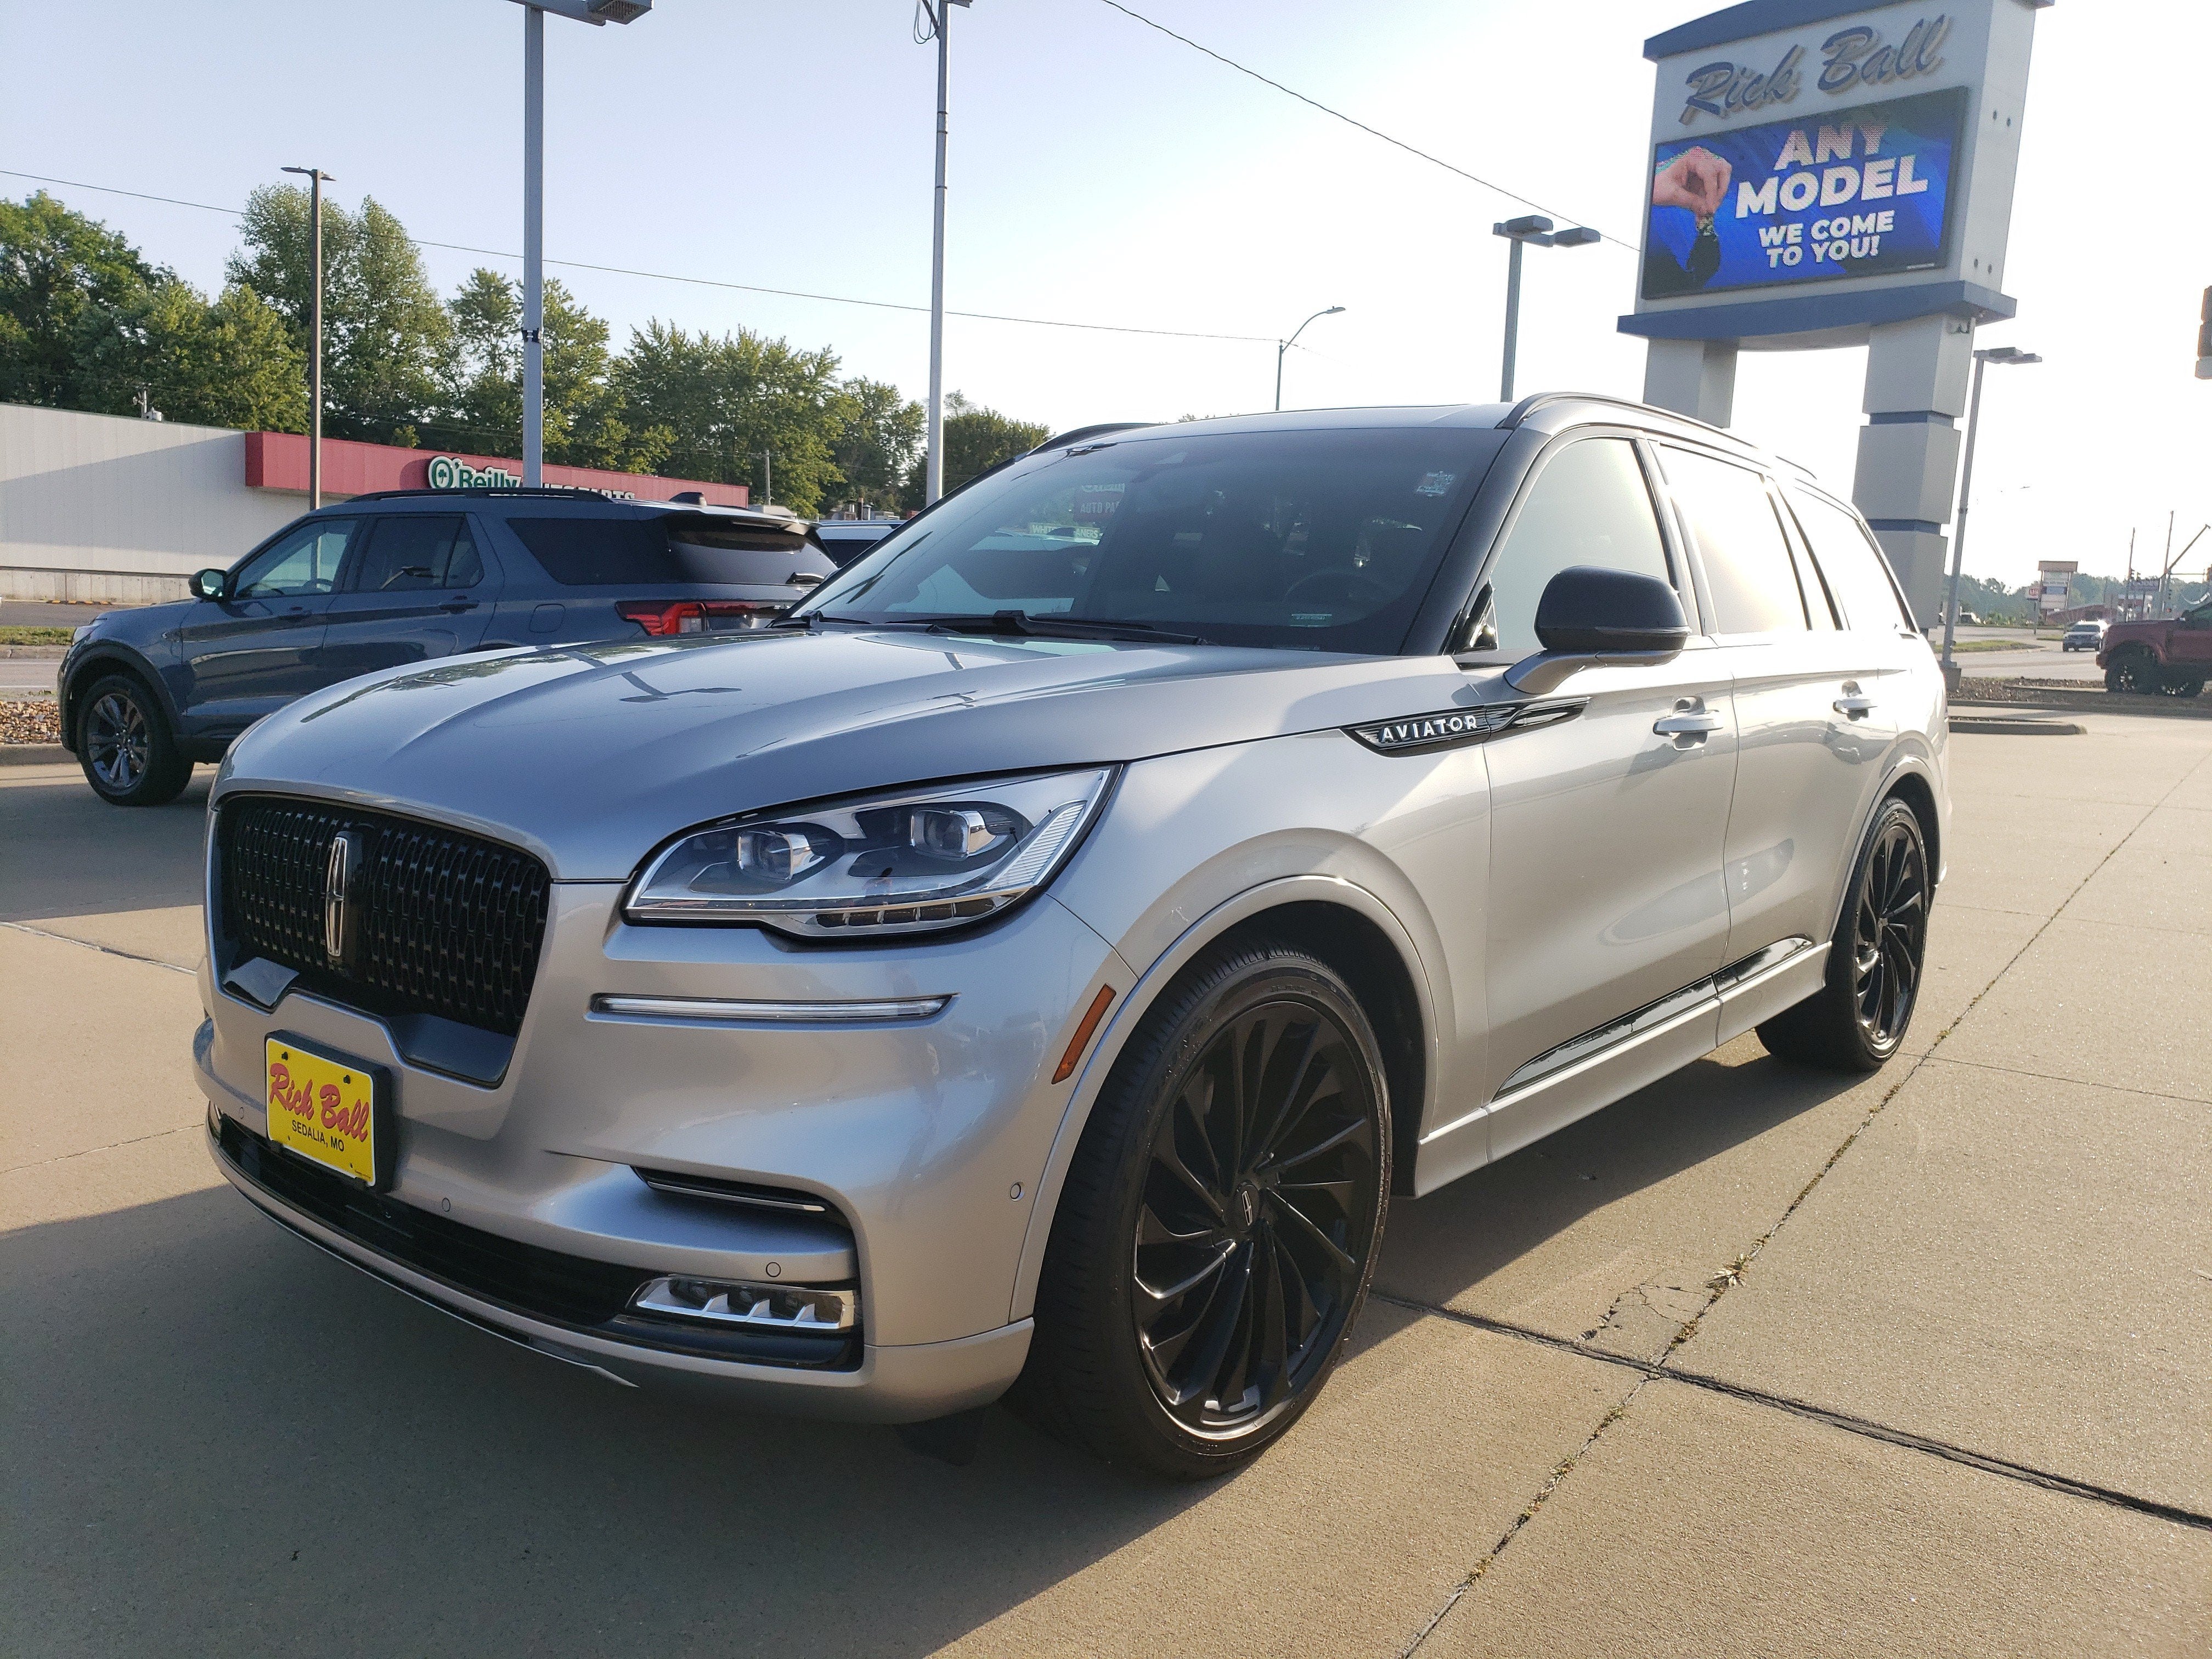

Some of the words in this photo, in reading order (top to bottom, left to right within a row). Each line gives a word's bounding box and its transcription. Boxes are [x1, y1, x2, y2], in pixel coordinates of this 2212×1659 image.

[1679, 44, 1807, 125] Rick
[1818, 13, 1951, 95] Ball
[1774, 122, 1889, 170] ANY
[1735, 155, 1928, 219] MODEL
[1759, 223, 1803, 247] WE
[1810, 210, 1895, 241] COME
[1766, 245, 1803, 269] TO
[1810, 235, 1881, 263] YOU!
[1080, 501, 1103, 514] AUTO
[1381, 715, 1477, 742] AVIATOR
[269, 1063, 314, 1120] Rick
[319, 1084, 369, 1143] Ball
[292, 1119, 329, 1148] SEDALIA,
[330, 1135, 345, 1152] MO
